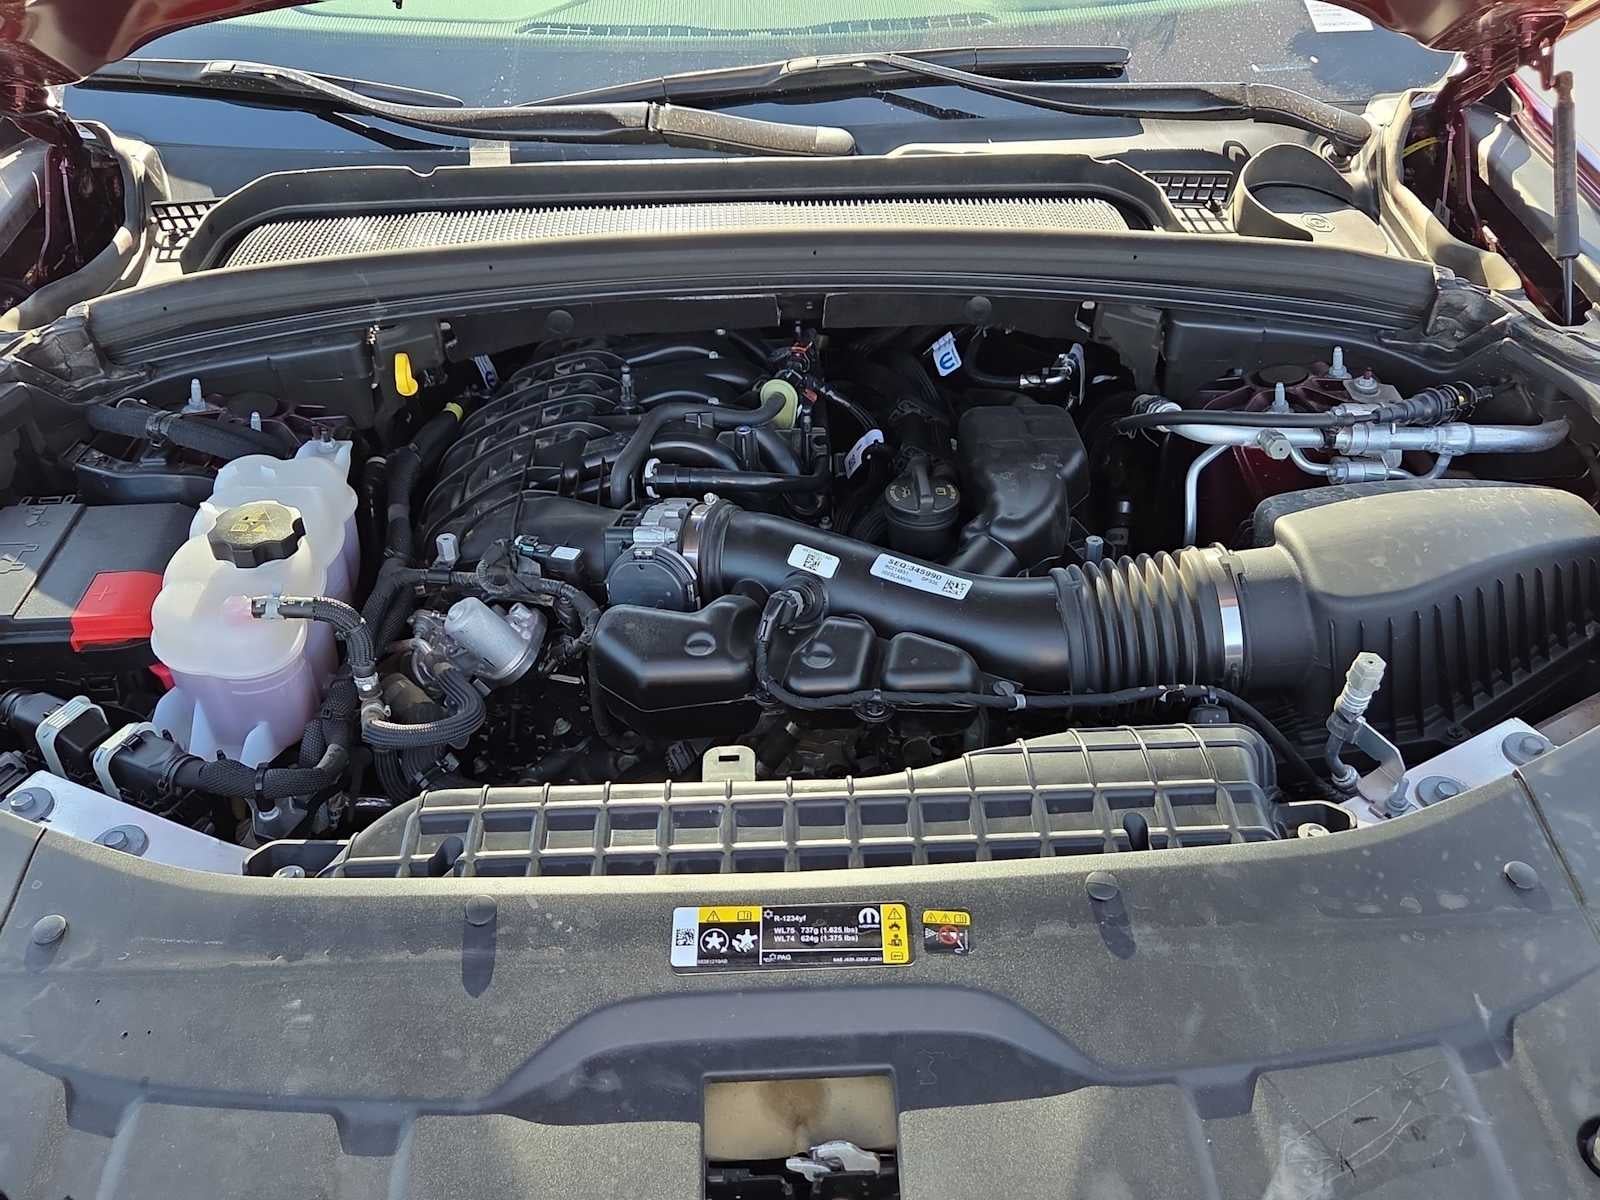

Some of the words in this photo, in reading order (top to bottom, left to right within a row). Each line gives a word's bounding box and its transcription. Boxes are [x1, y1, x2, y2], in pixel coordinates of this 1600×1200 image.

[773, 914, 807, 923] R-1234yf
[800, 926, 819, 935] 737g
[820, 926, 842, 935] (1.625
[844, 926, 859, 935] lbs)
[800, 935, 819, 943] 624g
[820, 934, 842, 943] (1.375
[844, 934, 859, 942] lbs)
